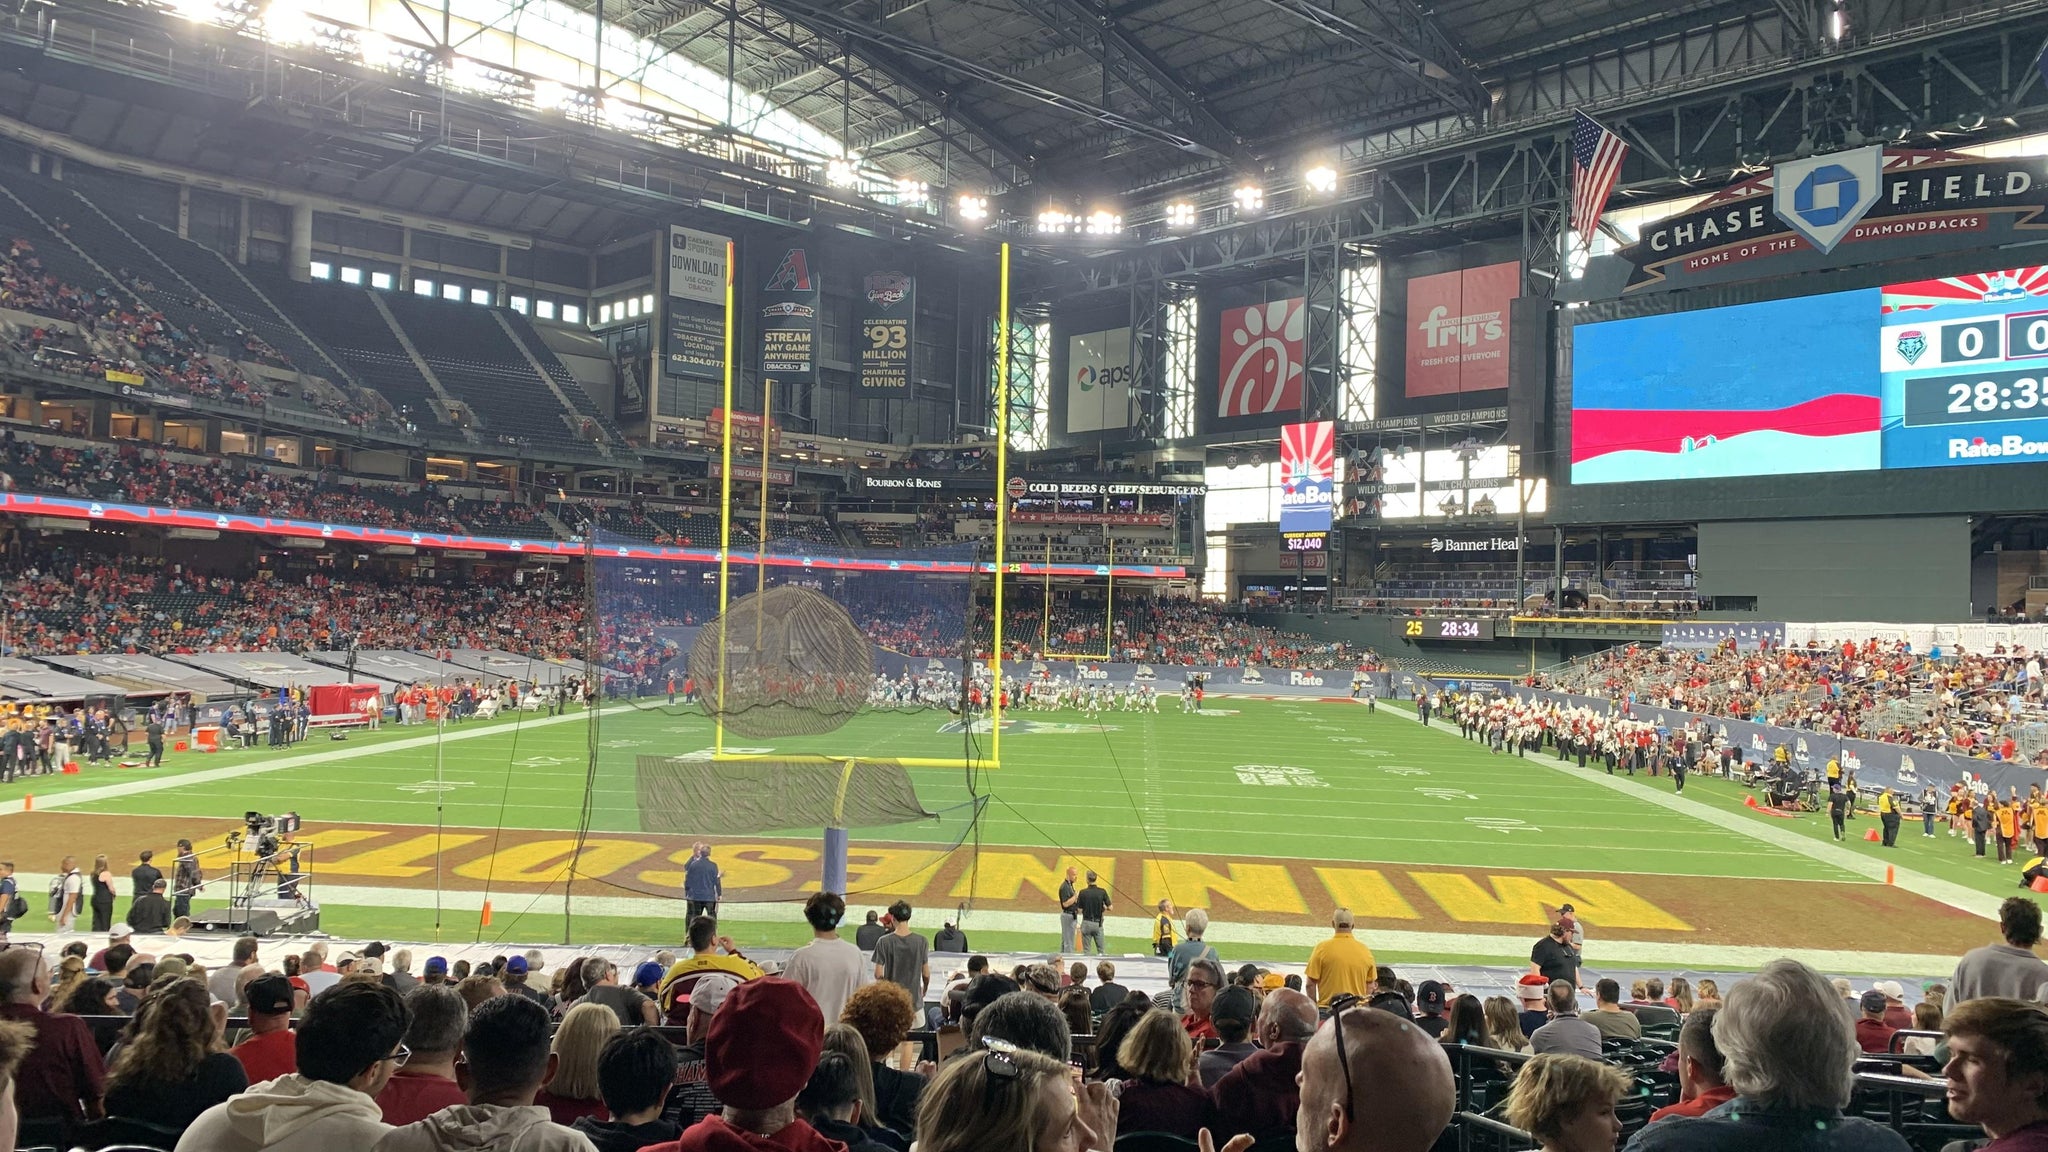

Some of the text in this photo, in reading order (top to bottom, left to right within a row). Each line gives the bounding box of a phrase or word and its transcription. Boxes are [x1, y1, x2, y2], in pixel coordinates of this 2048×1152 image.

[1651, 172, 2031, 251] CHASE FIELD
[1691, 217, 1978, 268] HOME OF THE DIAMONDBACKS
[672, 254, 718, 276] DOWNLOAD
[685, 275, 696, 283] USE
[764, 332, 811, 342] STREAM
[863, 325, 907, 349] $93
[1958, 327, 1984, 357] 0
[683, 341, 715, 352] LOCATION
[764, 344, 811, 352] ANY GAME
[672, 354, 725, 368] 623.304.0777
[764, 353, 811, 361] ANYWHERE
[862, 350, 907, 359] MILLION
[1421, 351, 1502, 367] FRESH FOR EVERYONE
[862, 377, 906, 387] GIVING
[1099, 365, 1130, 388] aps
[1434, 409, 1506, 423] WORLD CHAMPIONS
[1344, 417, 1418, 431] NL WEST CHAMPIONS
[1949, 435, 2048, 458] RateBow
[906, 478, 914, 488] &
[1029, 484, 1206, 495] COLD BEERS & CHEESEBURGERS
[1357, 484, 1398, 495] WILD CARD
[1438, 478, 1499, 490] NL CHAMPIONS
[1288, 538, 1322, 550] $12,040
[1445, 537, 1529, 552] Banner Heal
[1406, 621, 1479, 637] 25 28:34
[1078, 665, 1108, 680] Rate
[1291, 671, 1324, 686] Rate
[1841, 749, 1861, 769] Rate
